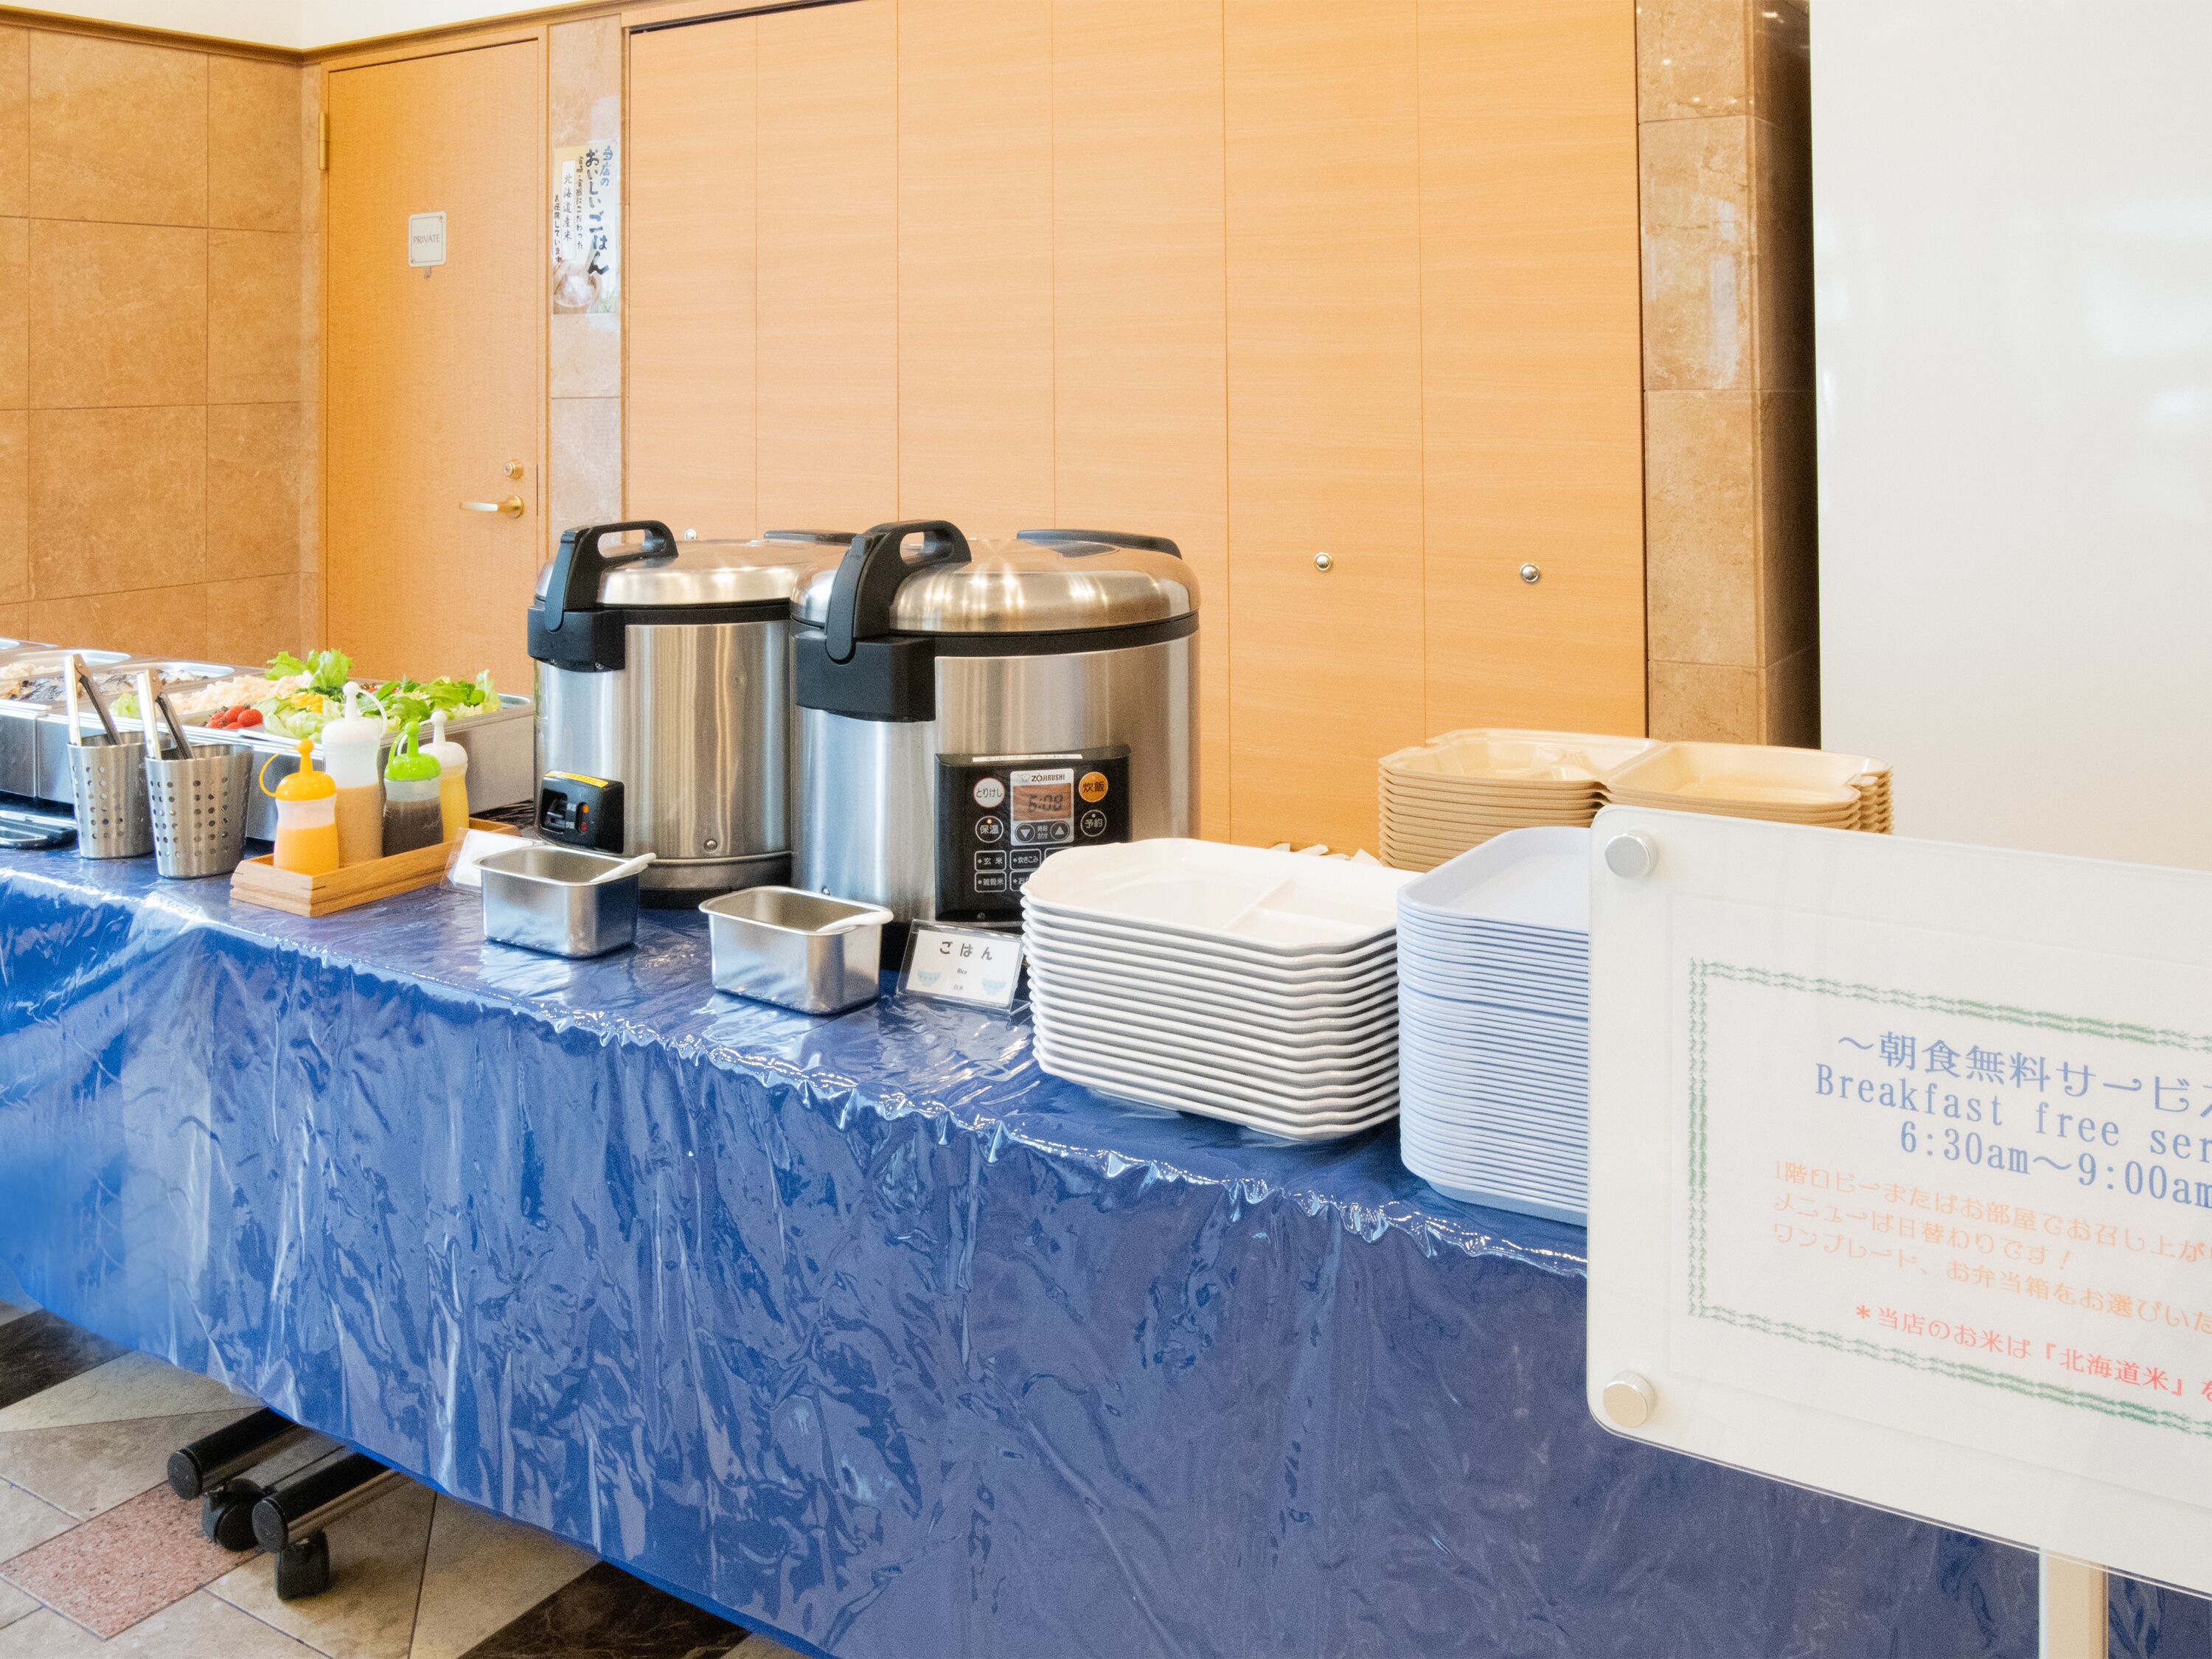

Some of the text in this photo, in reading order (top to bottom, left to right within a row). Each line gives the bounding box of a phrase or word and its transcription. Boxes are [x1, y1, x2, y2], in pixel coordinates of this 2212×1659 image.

[599, 145, 613, 187] 当店の
[563, 173, 573, 241] 北海道産米
[585, 148, 610, 275] おいしいごはん
[413, 234, 440, 244] PRIVATE
[1032, 773, 1065, 783] ZOJIRUSHI
[976, 787, 1003, 799] とりけし
[1082, 781, 1105, 793] 炊飯
[1085, 818, 1103, 828] 予約
[979, 824, 1000, 835] 保温
[1018, 855, 1039, 864] 炊きこみ
[939, 941, 992, 961] ごはん
[1815, 1062, 2212, 1164] Breakfast free ser
[1775, 1160, 2212, 1262] 1階ロビーまたはお部屋でお召し上が
